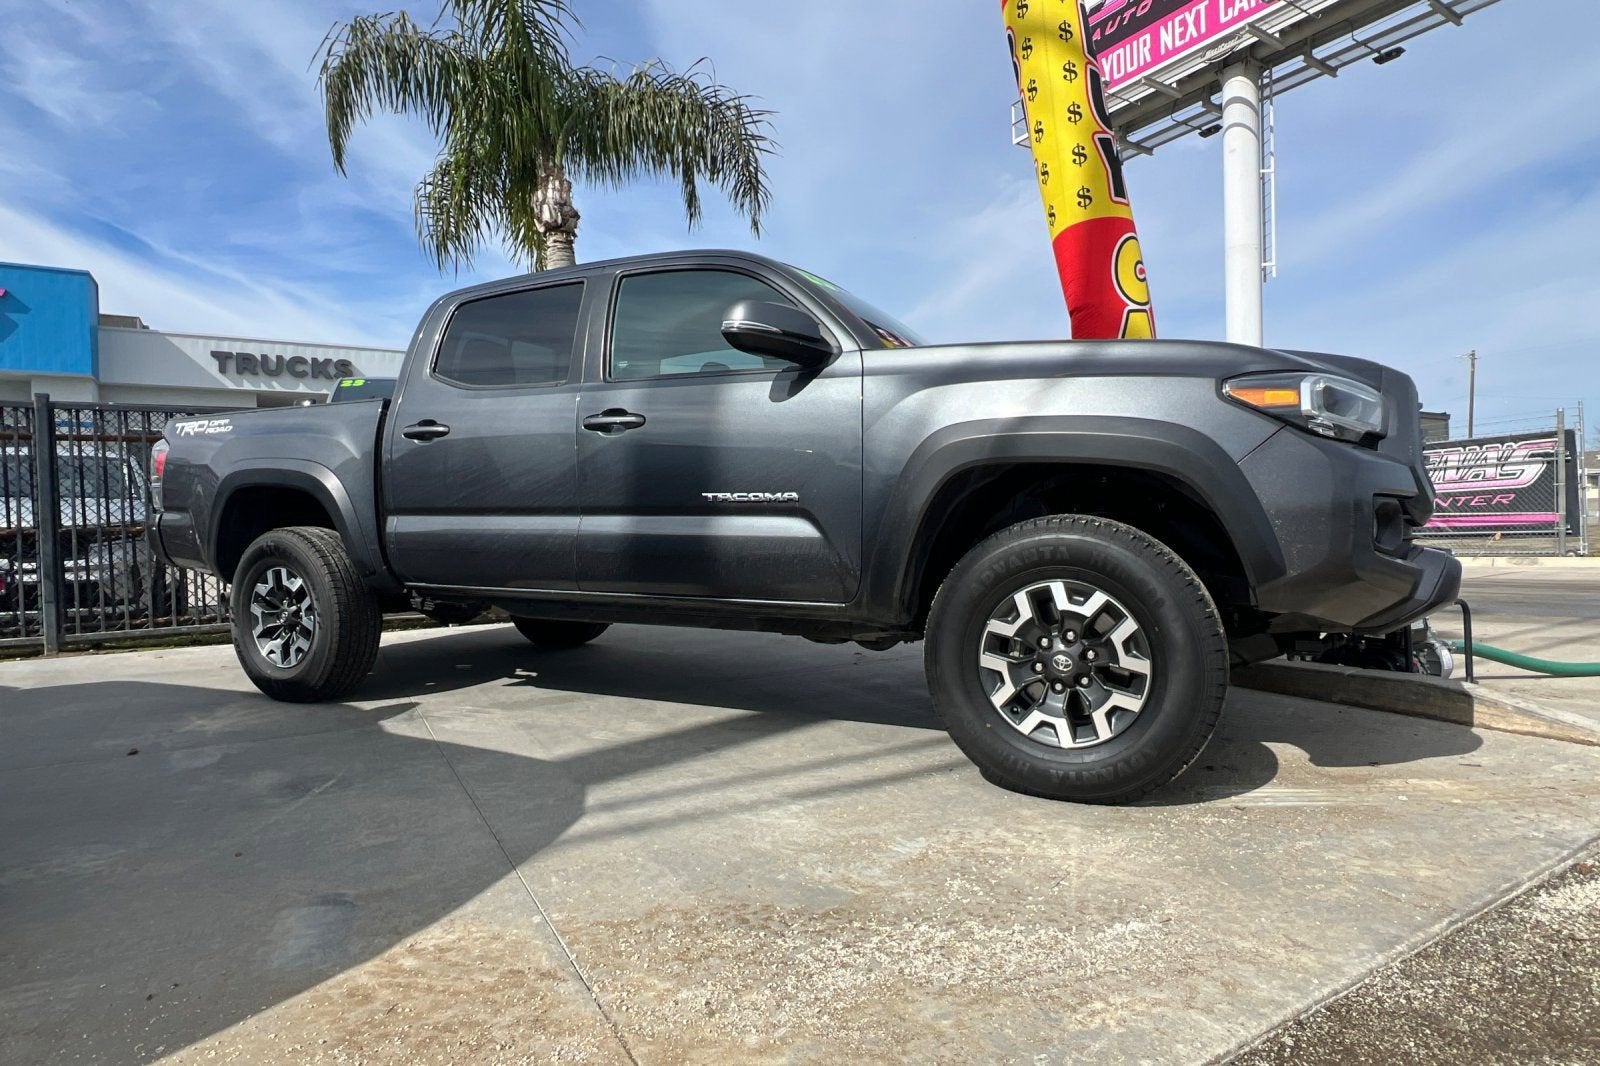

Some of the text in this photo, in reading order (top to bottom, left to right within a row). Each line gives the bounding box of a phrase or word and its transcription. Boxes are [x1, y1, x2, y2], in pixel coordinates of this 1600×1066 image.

[1092, 0, 1152, 40] AUTO
[1101, 32, 1151, 82] YOUR
[1159, 1, 1206, 55] NEXT
[1219, 0, 1264, 24] CA
[210, 350, 354, 379] TRUCKS
[175, 420, 208, 437] TRD
[205, 425, 233, 434] ROAD
[701, 491, 799, 502] TACOMA
[1433, 493, 1517, 507] NTER
